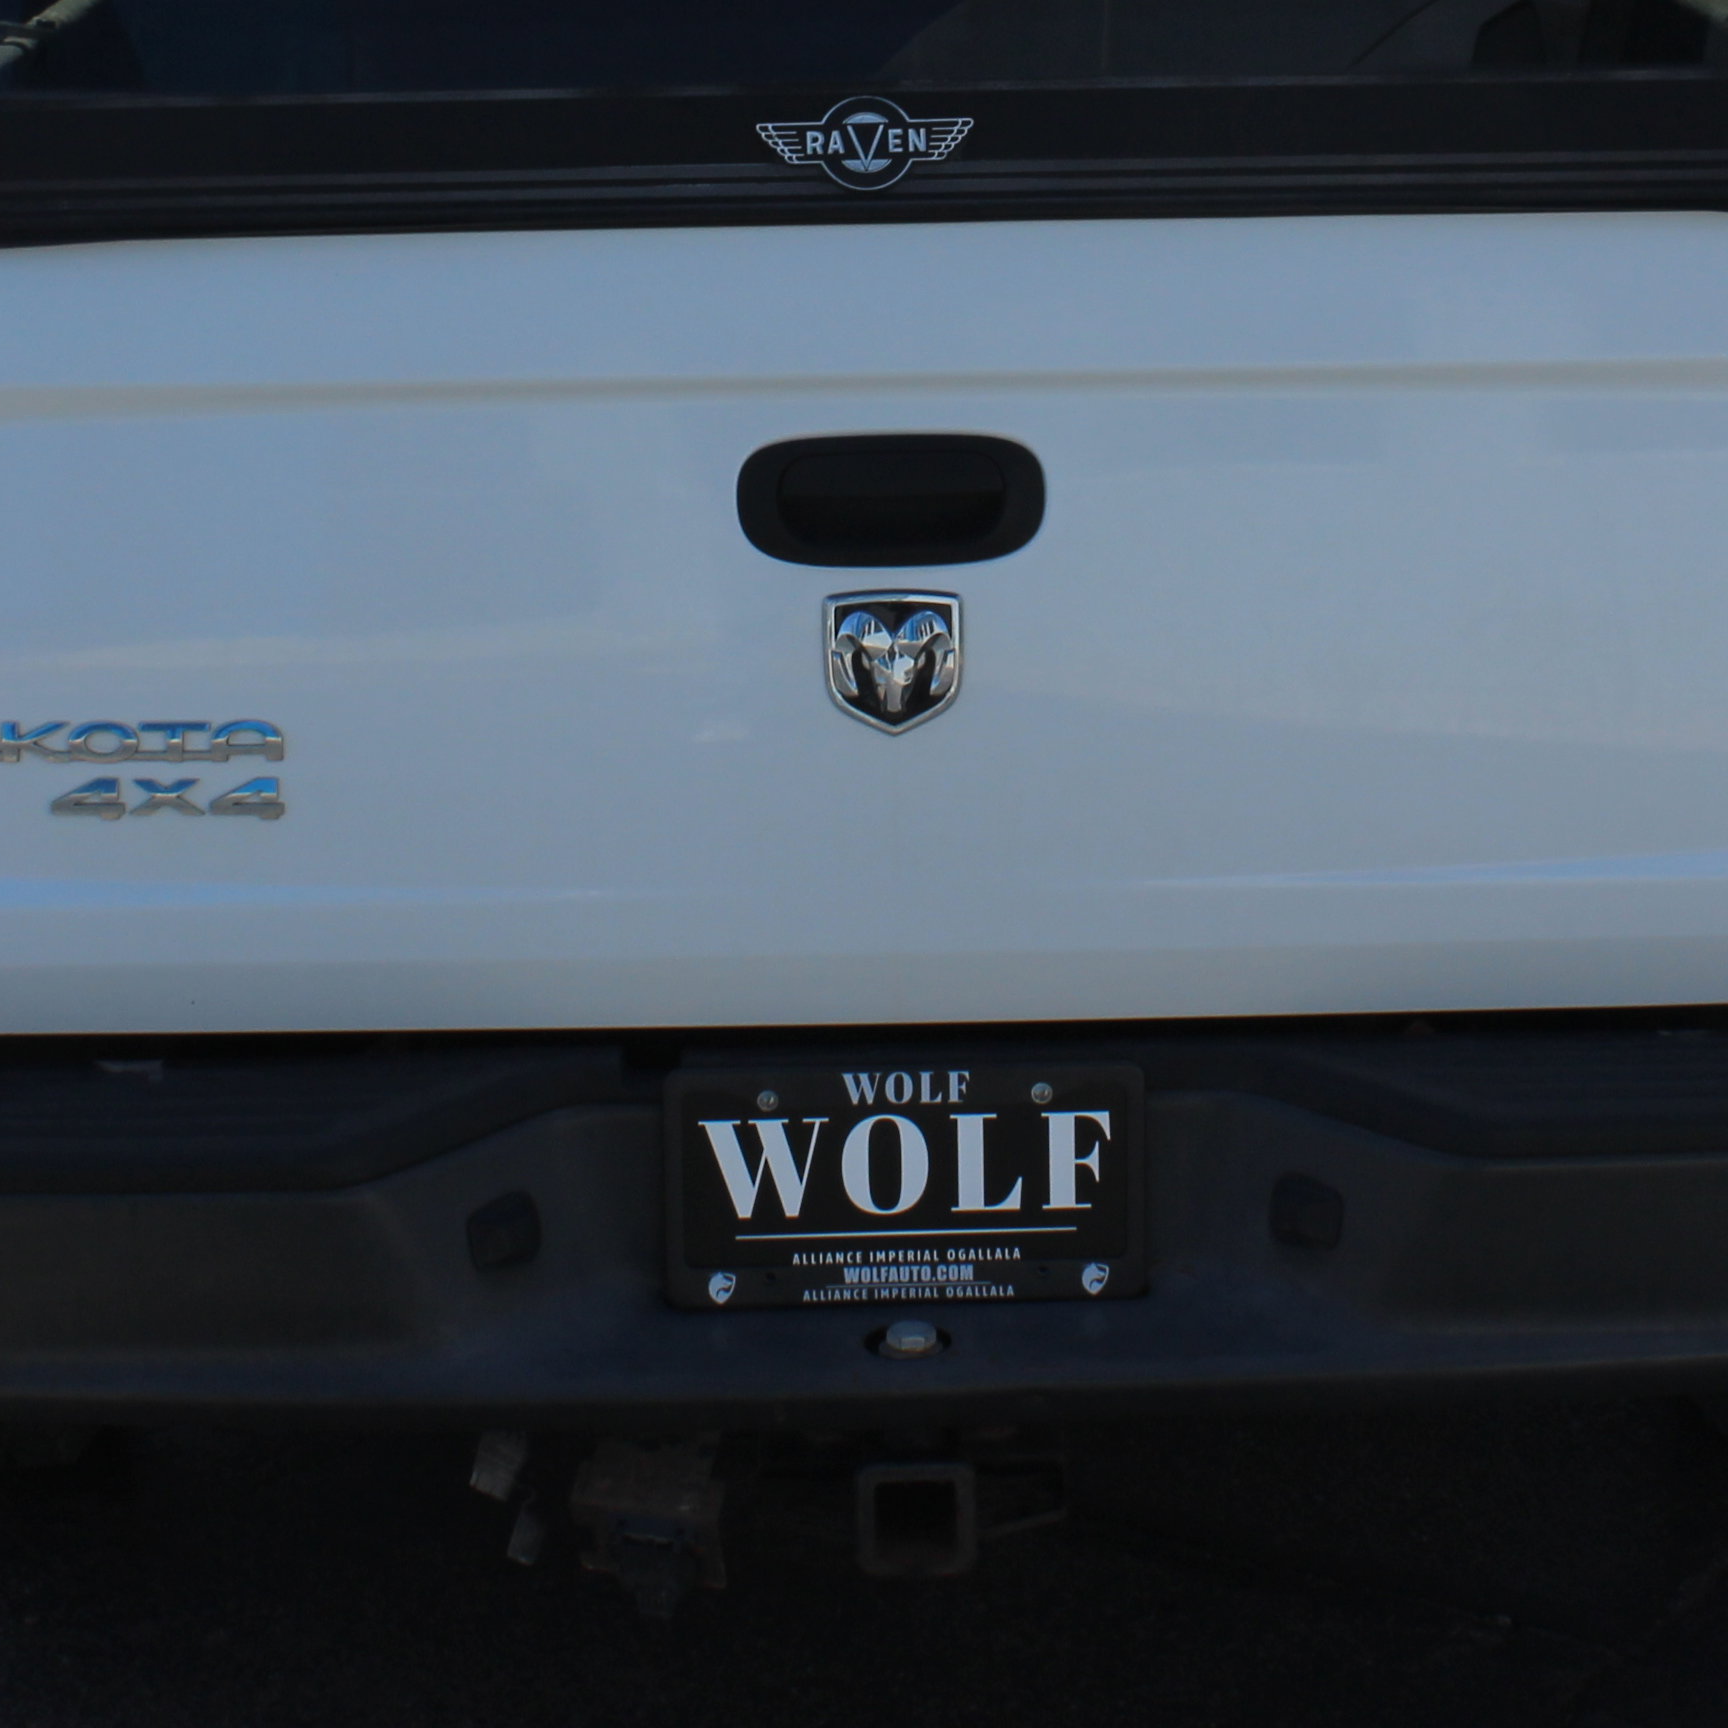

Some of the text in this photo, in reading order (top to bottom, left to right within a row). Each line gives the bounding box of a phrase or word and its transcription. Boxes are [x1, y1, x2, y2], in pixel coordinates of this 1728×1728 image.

[805, 124, 927, 172] RAVEN
[50, 777, 285, 821] 4X4
[842, 1071, 970, 1105] WOLF
[698, 1110, 1111, 1220] WOLF
[792, 1247, 1021, 1266] ALLIANCE IMPERIAL OGALLALA
[843, 1263, 974, 1284] WOLFAUTO.COM
[802, 1285, 1015, 1303] ALLIANCE IMPERIAL OGALLALA
